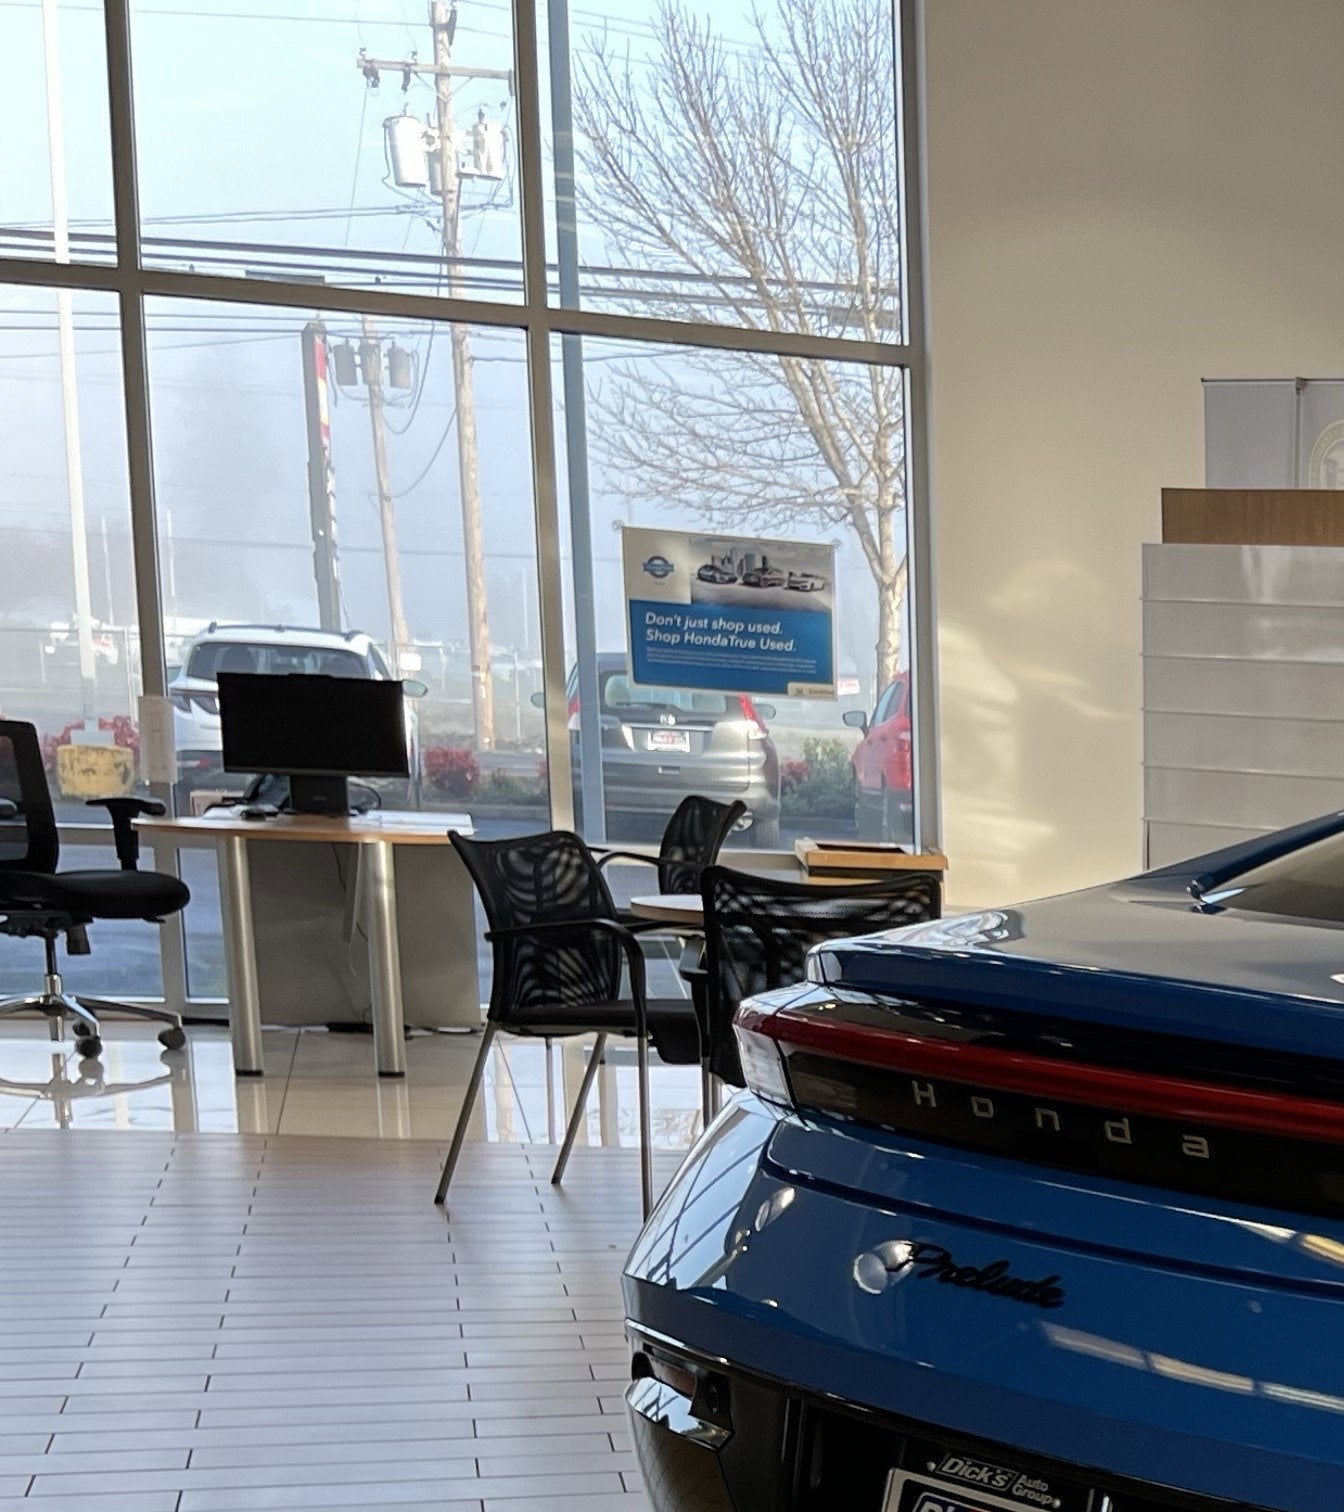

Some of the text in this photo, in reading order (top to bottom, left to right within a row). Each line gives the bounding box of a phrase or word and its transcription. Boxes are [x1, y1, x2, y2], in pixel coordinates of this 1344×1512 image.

[645, 611, 783, 635] Don't just shop used.
[646, 627, 798, 652] Shop HondaTrue Used.
[912, 1080, 1211, 1160] Honda
[893, 1240, 1067, 1309] Prelude
[941, 1457, 1009, 1487] Dick's
[1018, 1474, 1050, 1492] Auto
[1011, 1483, 1054, 1506] Group
